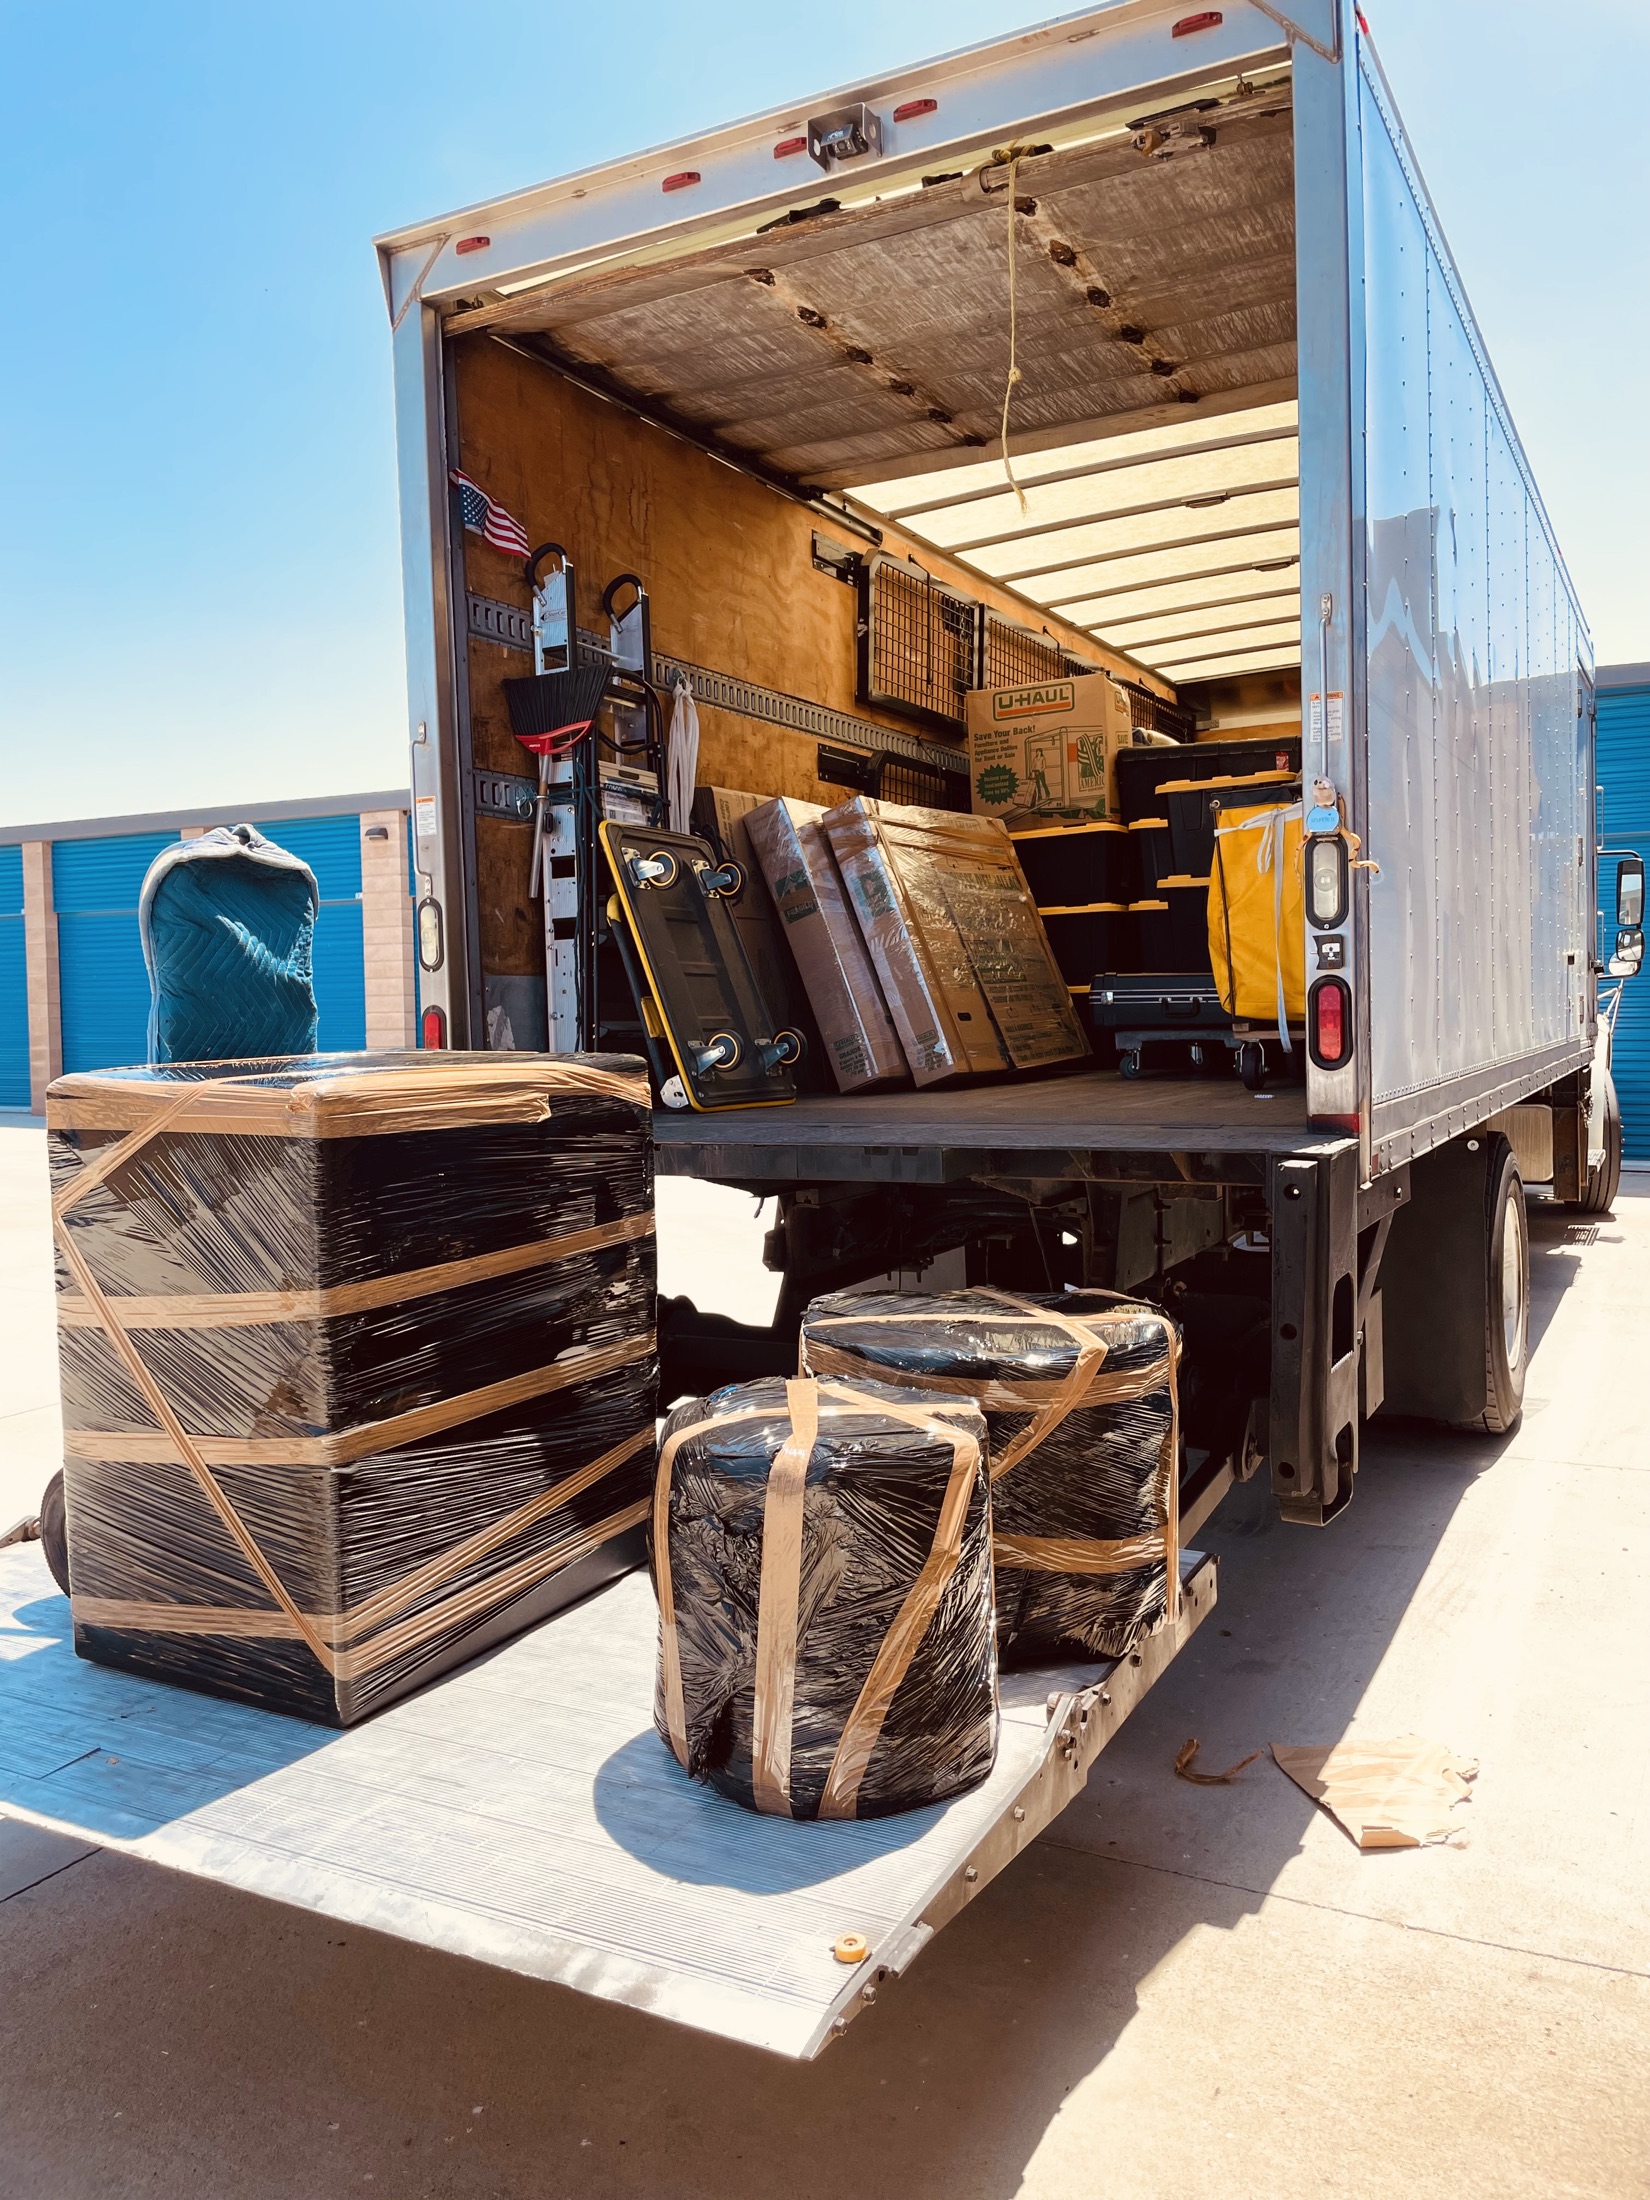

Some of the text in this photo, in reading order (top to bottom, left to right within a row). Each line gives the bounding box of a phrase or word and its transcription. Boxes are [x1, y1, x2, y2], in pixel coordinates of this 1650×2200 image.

[999, 688, 1069, 709] U-HAUL
[974, 725, 1035, 741] Save Your Back!
[974, 740, 998, 748] Furniture
[975, 747, 999, 756] Appliance
